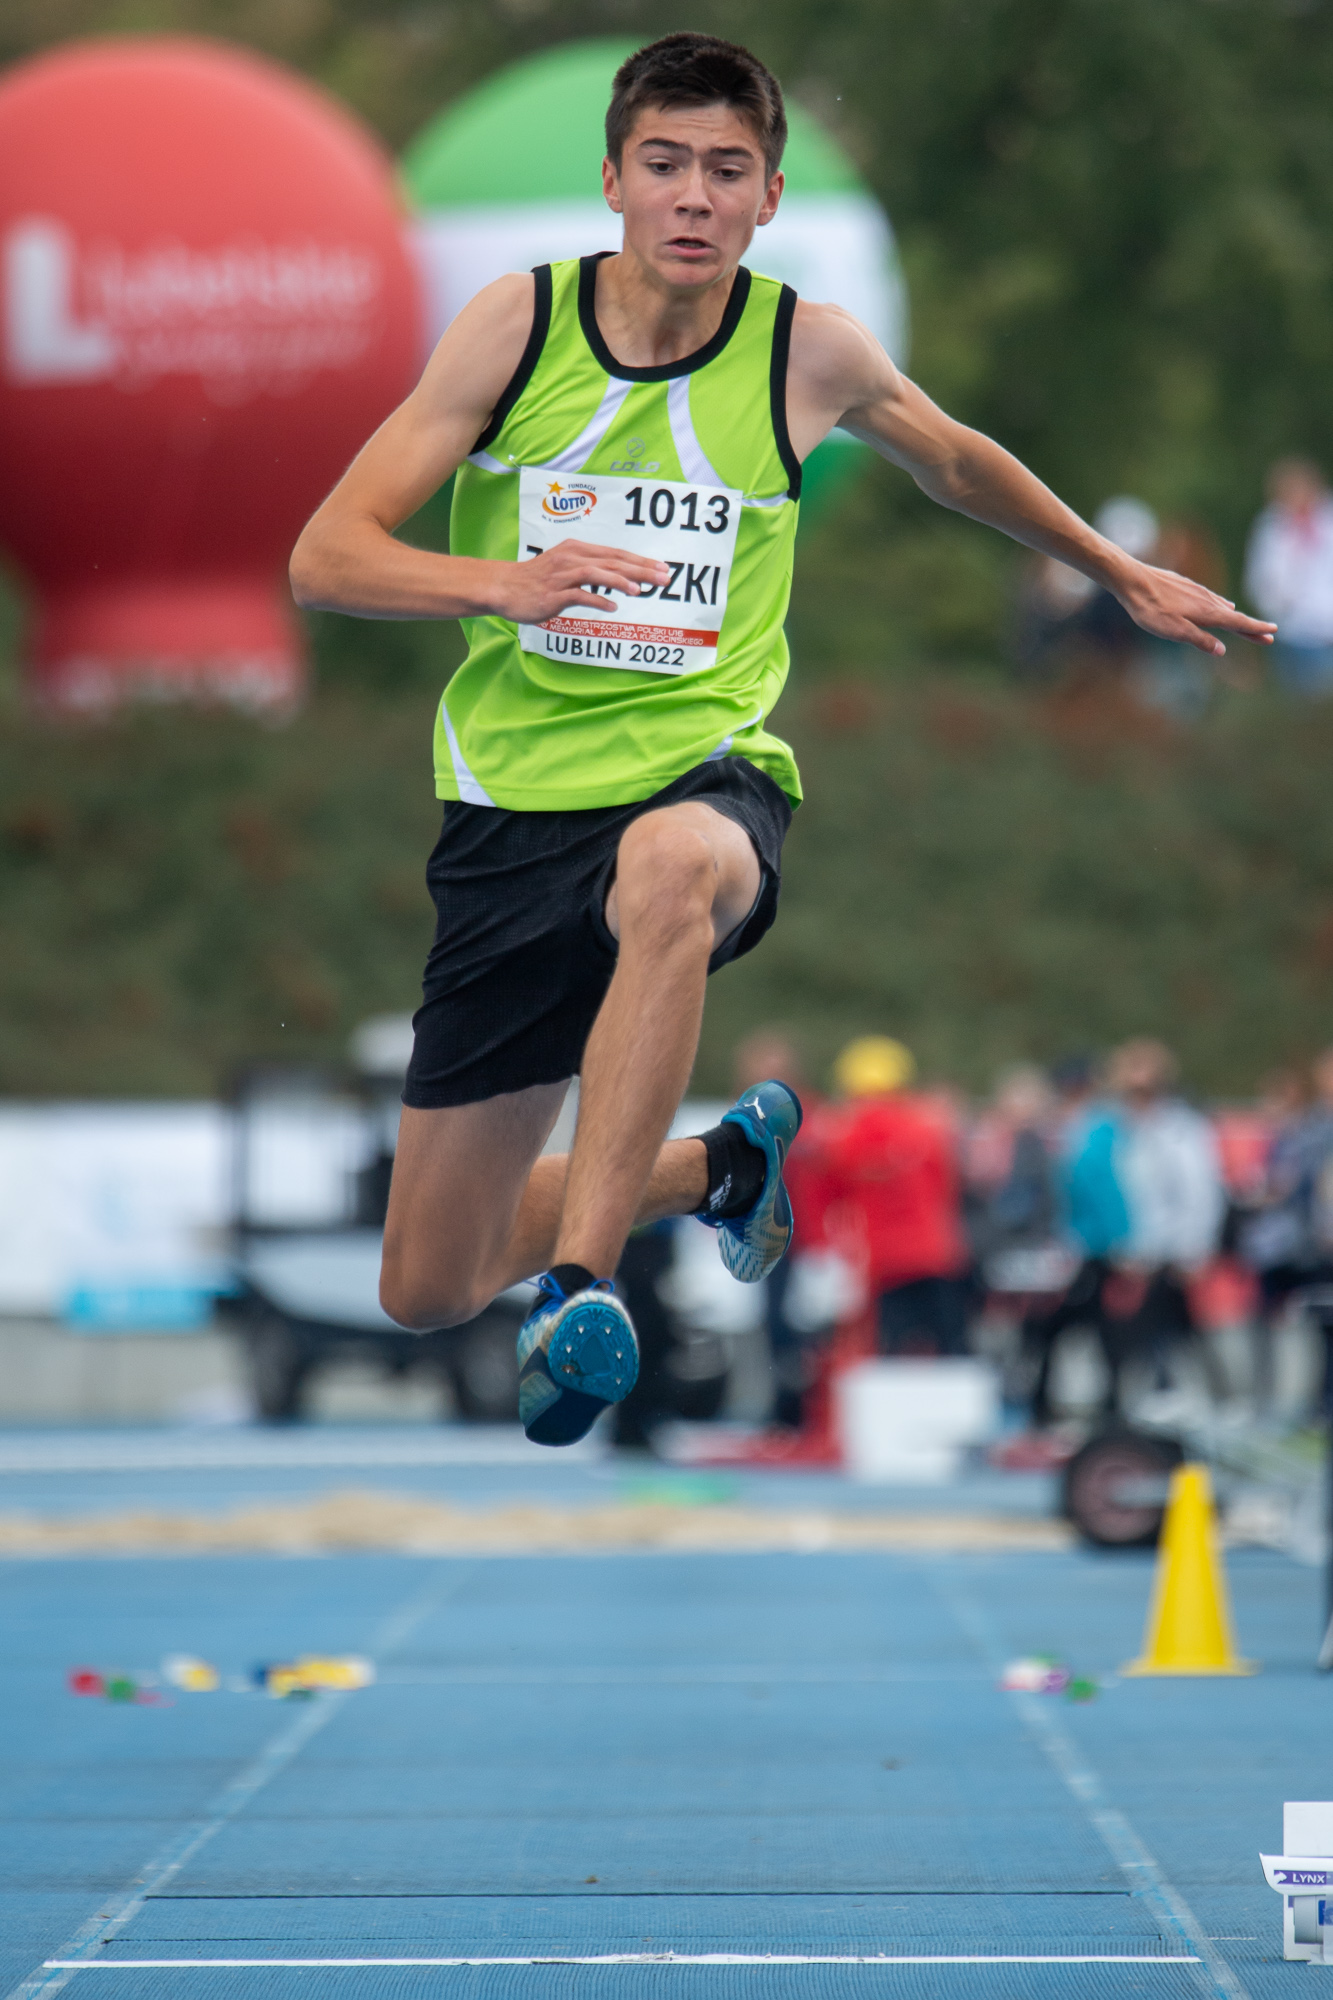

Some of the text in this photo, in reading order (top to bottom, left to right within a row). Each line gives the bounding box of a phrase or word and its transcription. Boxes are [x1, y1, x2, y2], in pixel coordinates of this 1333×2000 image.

[552, 496, 586, 511] LOTTO
[625, 486, 731, 535] 1013
[572, 621, 635, 632] MISTRZOSTWA
[637, 627, 667, 635] POLSKI
[668, 630, 684, 638] U16
[597, 629, 638, 640] JANUSZA
[546, 633, 685, 667] LUBLIN 2022
[1292, 1872, 1326, 1884] LYNX
